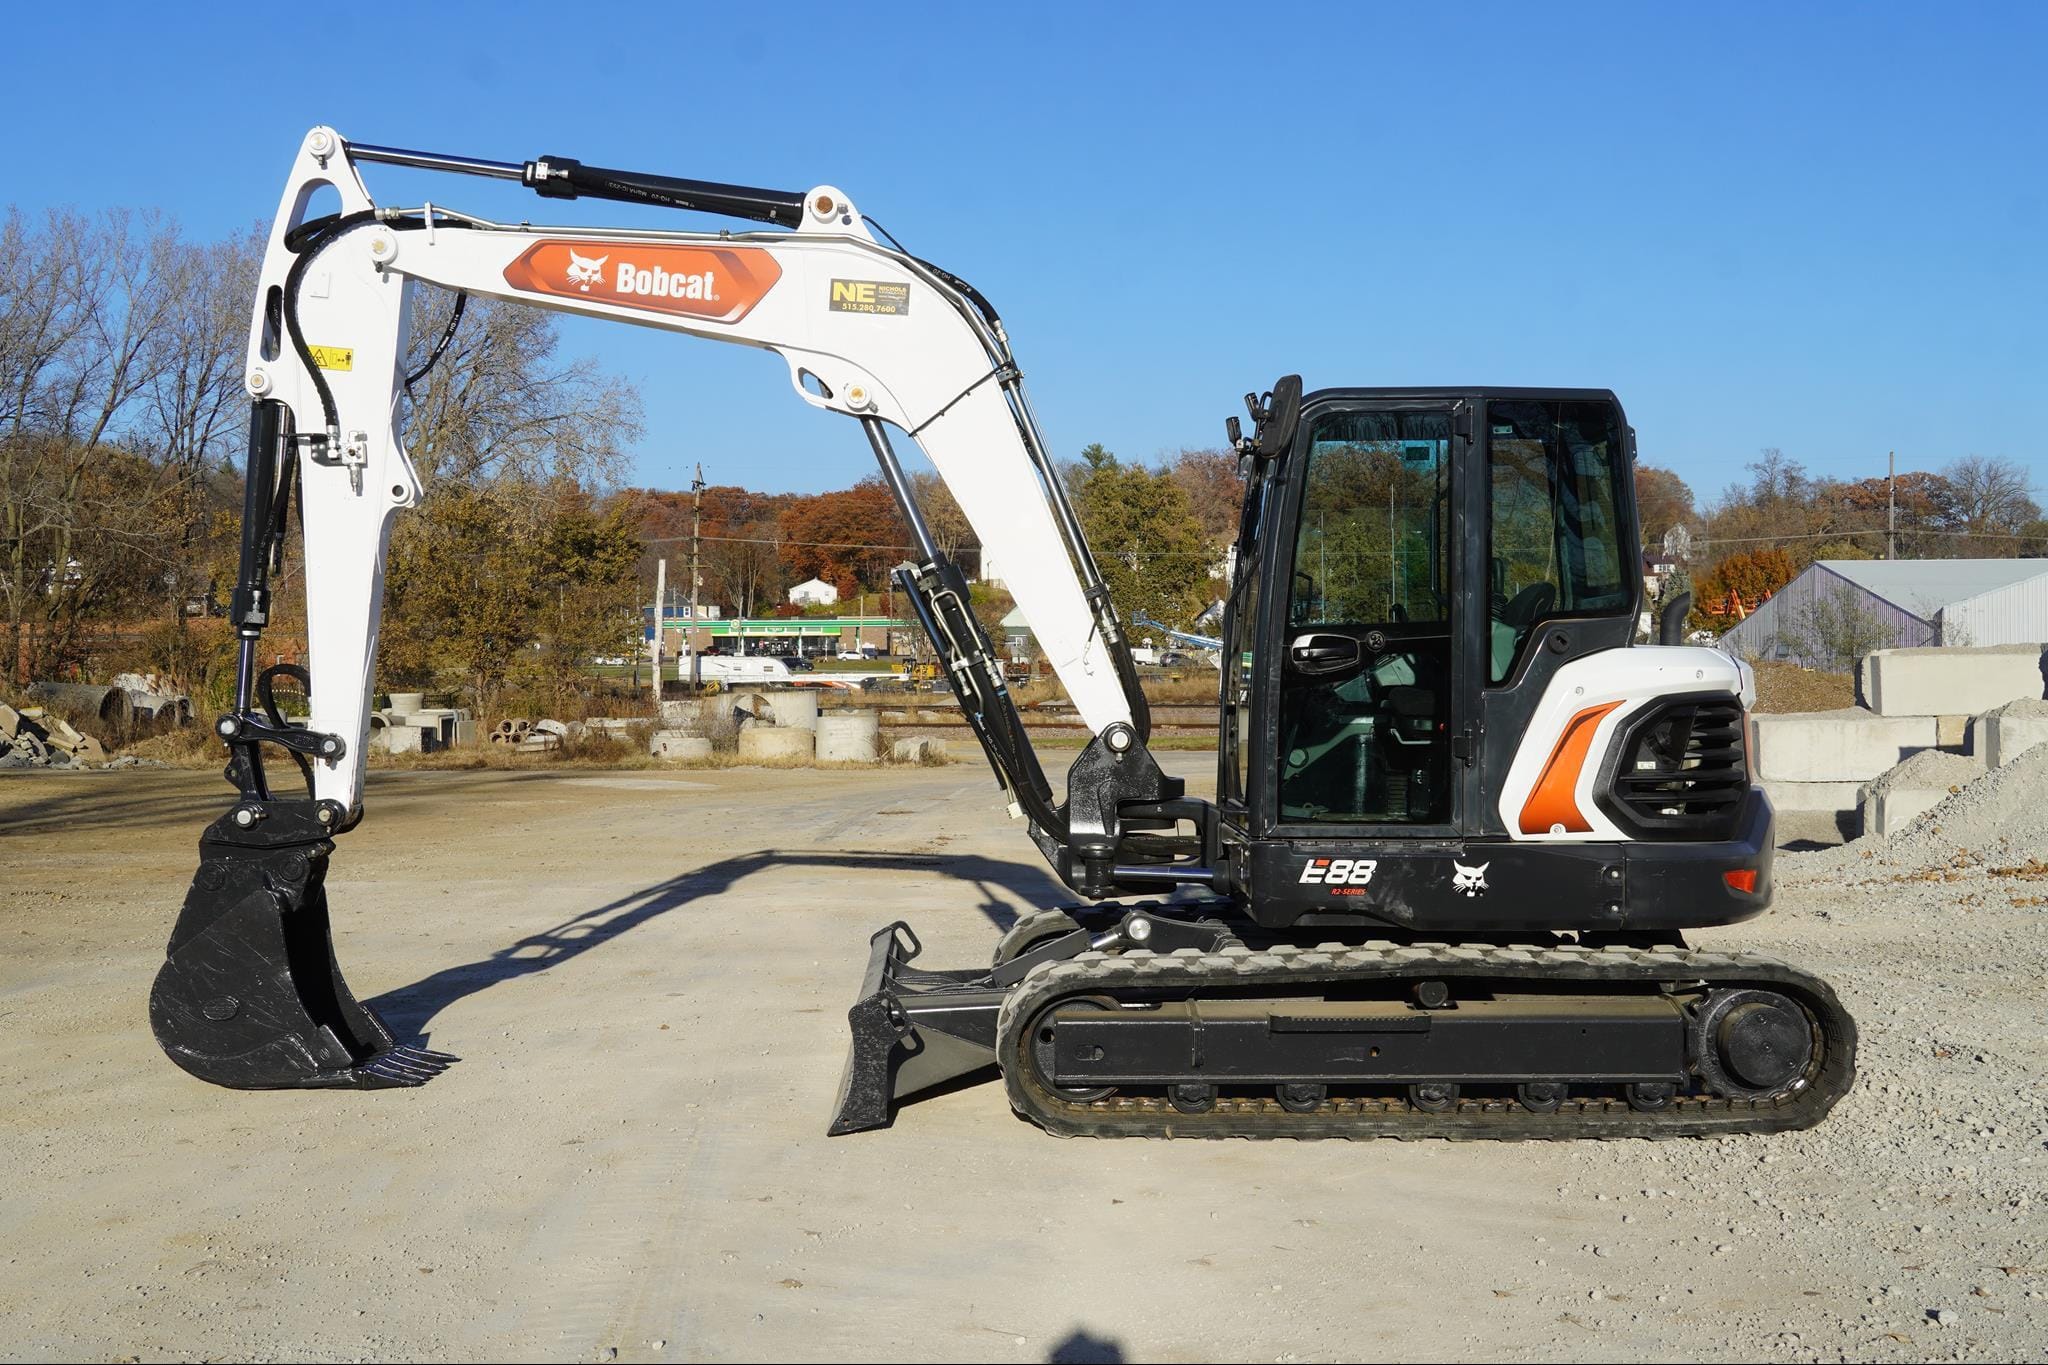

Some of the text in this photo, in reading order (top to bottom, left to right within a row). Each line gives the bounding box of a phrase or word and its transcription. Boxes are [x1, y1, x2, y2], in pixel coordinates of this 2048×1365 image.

[616, 263, 714, 301] Bobcat
[833, 282, 876, 303] NE
[842, 303, 896, 313] 515.280.7600
[1298, 859, 1377, 885] E88
[1331, 887, 1367, 896] R2-SERIES
